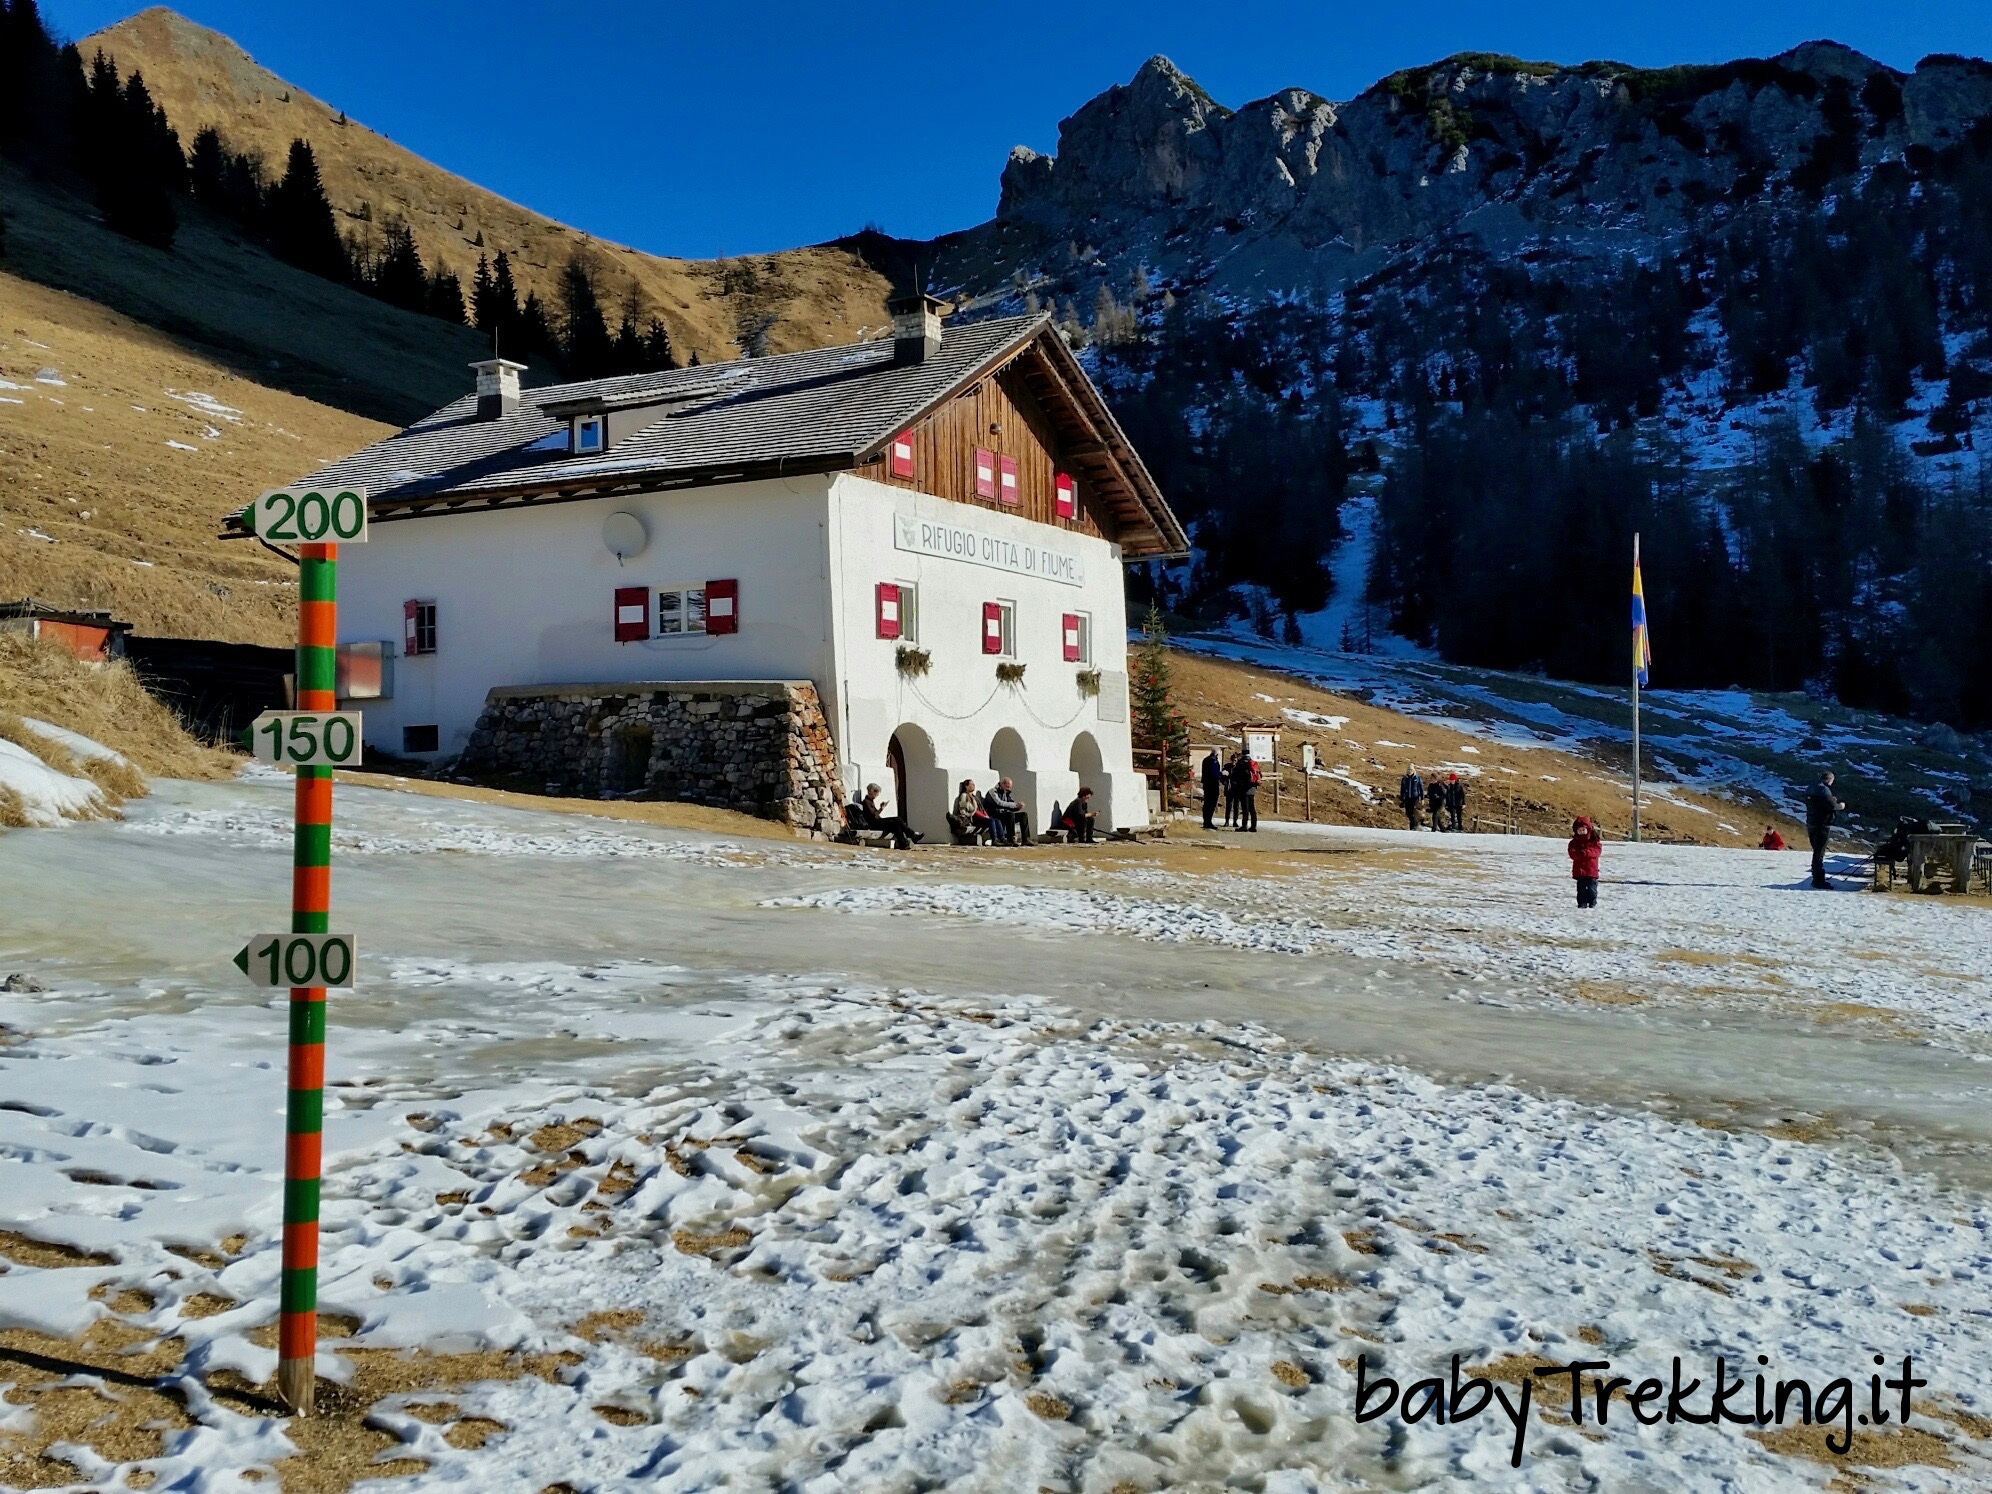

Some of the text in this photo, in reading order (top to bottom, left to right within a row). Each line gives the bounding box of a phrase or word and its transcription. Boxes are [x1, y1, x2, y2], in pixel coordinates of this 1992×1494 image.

[264, 491, 364, 541] 200
[922, 523, 976, 557] RIFUGIO
[1025, 547, 1036, 571] DI
[1042, 551, 1075, 580] FIUME
[260, 717, 355, 763] 150
[258, 937, 351, 986] 100
